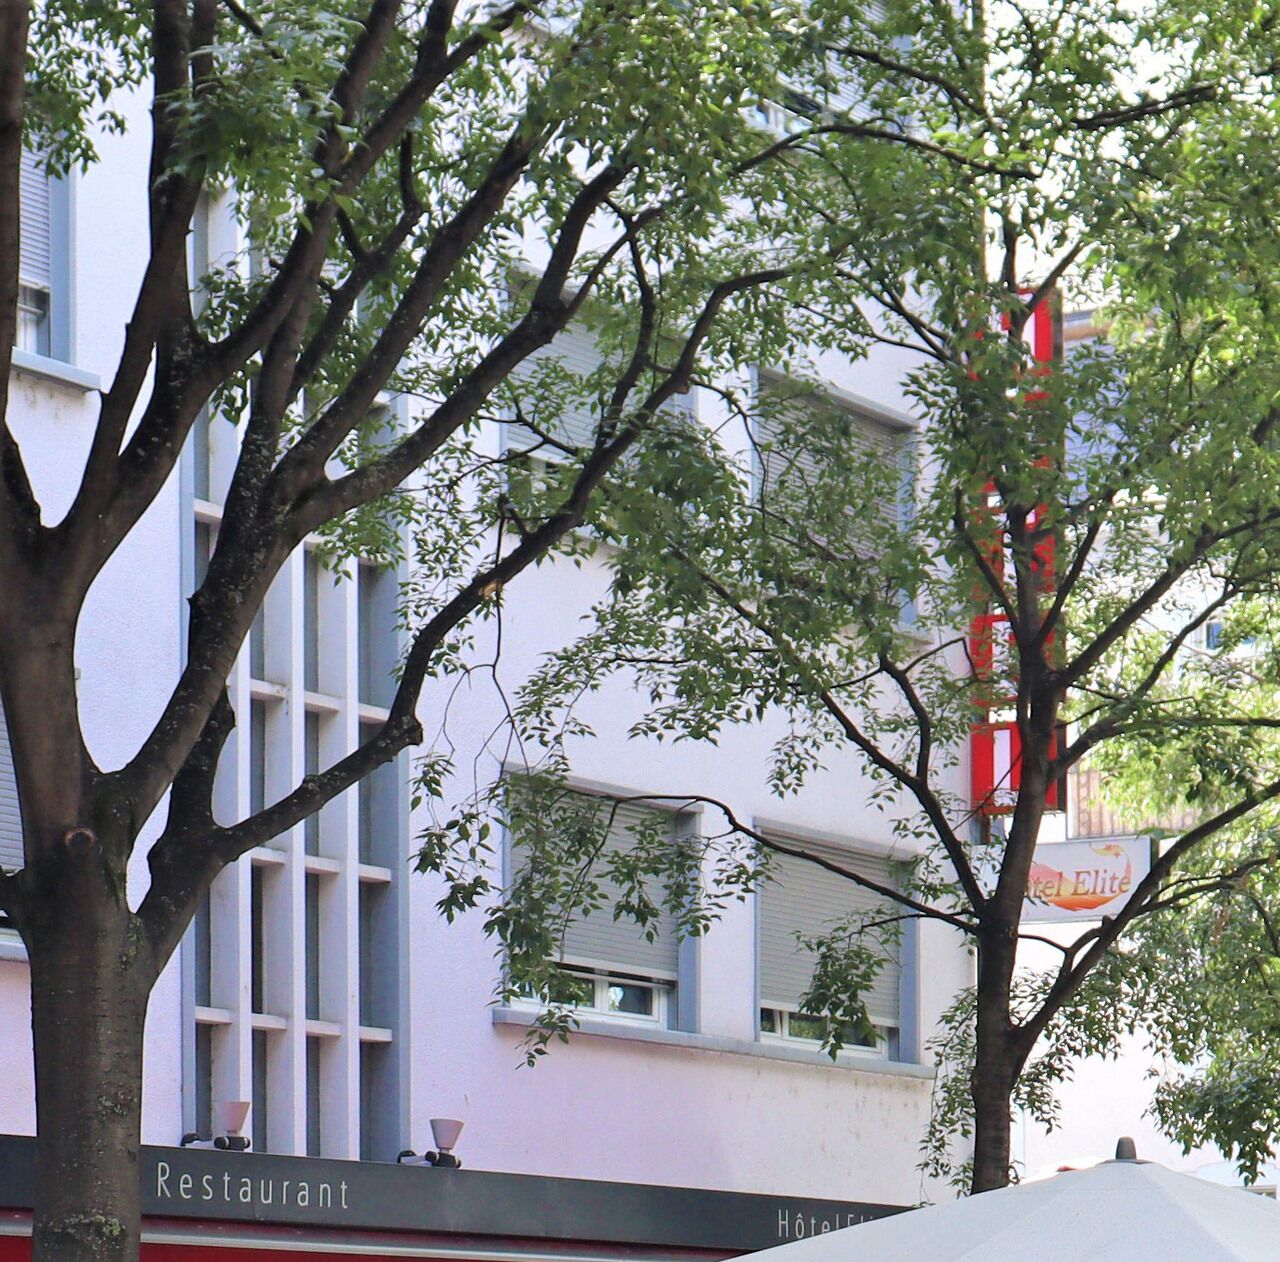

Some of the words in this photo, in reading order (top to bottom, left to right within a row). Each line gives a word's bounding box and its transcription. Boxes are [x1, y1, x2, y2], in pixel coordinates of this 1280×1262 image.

[1026, 872, 1064, 898] tel
[1072, 868, 1132, 896] Elite
[157, 1161, 348, 1209] Restaurant
[778, 1208, 840, 1239] Hôtel
